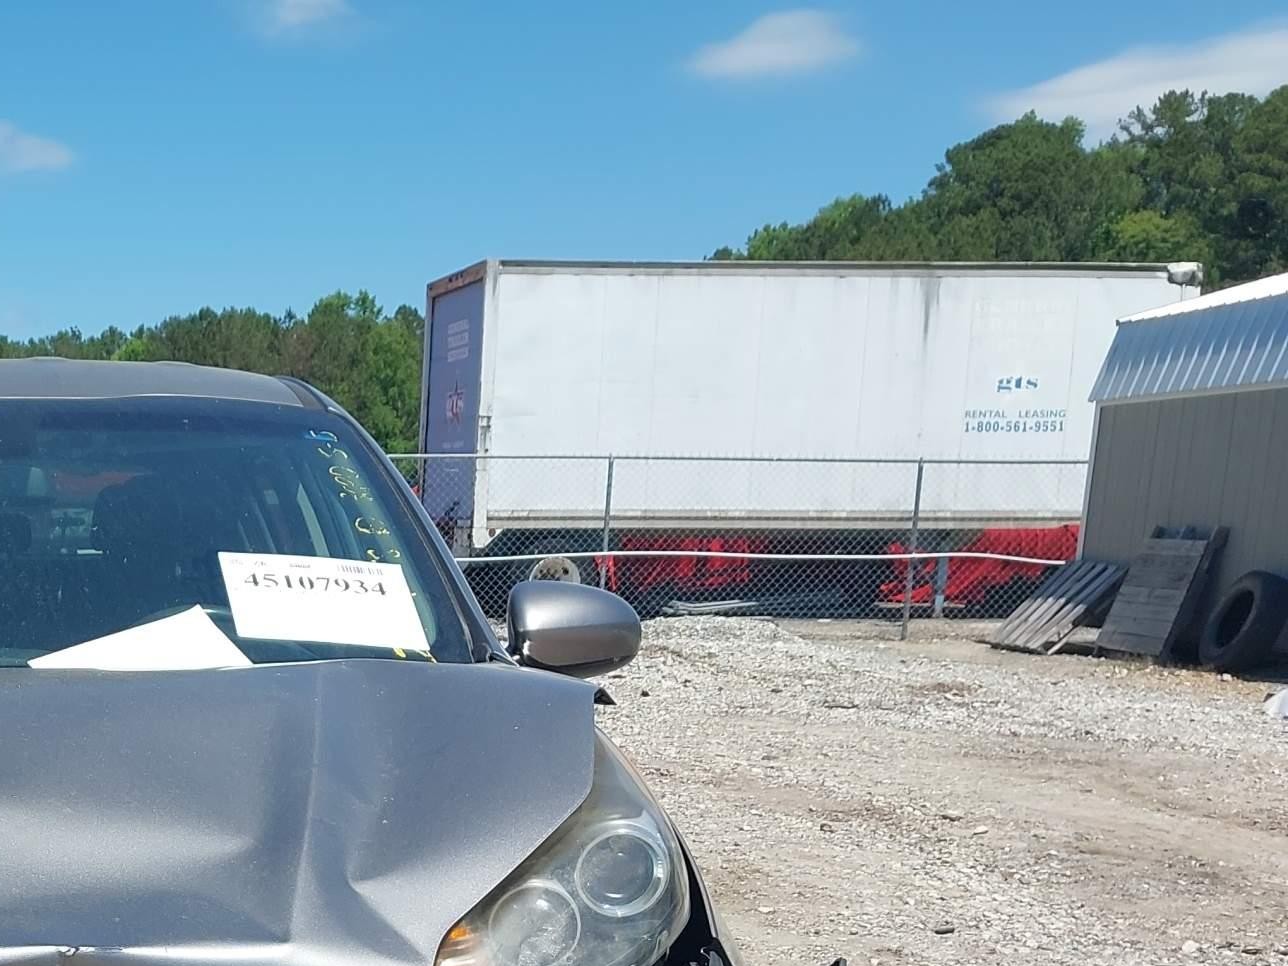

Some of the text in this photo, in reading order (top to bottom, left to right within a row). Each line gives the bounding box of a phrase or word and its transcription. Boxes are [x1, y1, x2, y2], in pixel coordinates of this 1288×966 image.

[996, 376, 1038, 393] gts
[964, 409, 1066, 419] RENTAL LEASING
[964, 420, 1065, 433] 1-800-561-9551
[244, 572, 387, 596] 45107934
